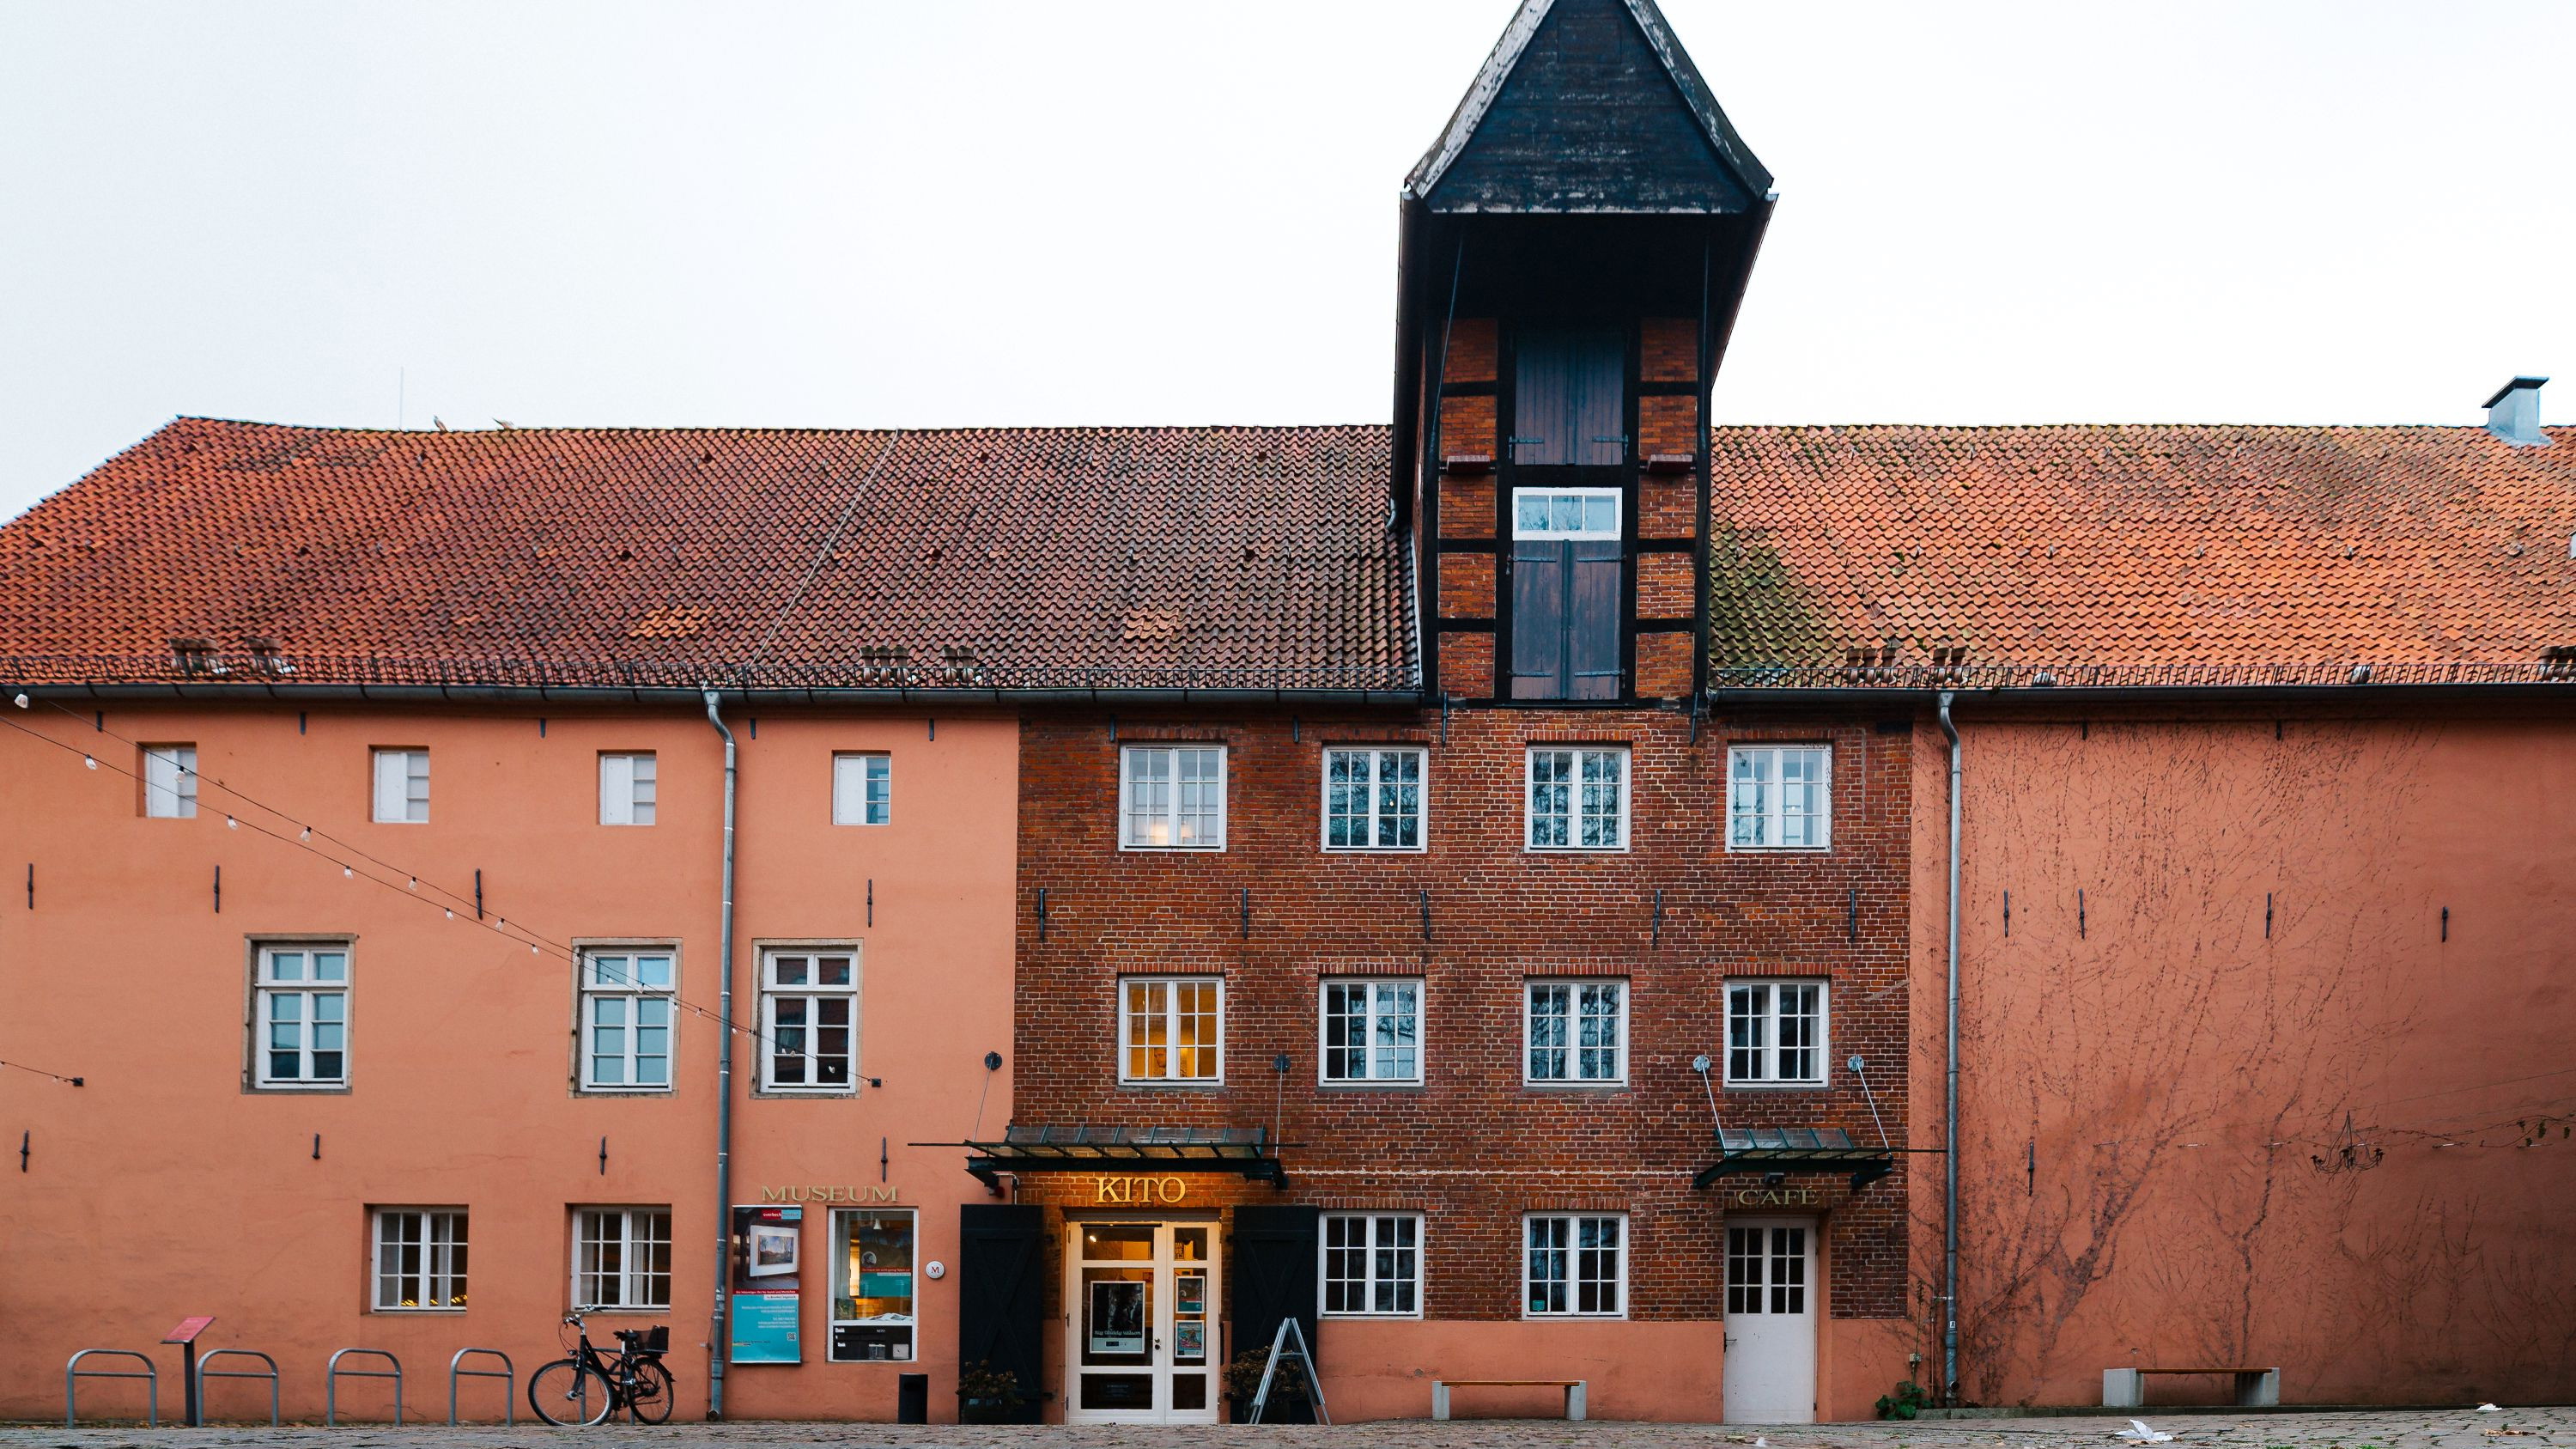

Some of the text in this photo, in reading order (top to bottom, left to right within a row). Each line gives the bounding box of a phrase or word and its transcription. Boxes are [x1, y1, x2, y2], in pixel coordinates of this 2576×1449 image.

[762, 1185, 897, 1202] MUSEUM
[1096, 1177, 1186, 1202] KITO
[1738, 1186, 1819, 1205] CAFÉ
